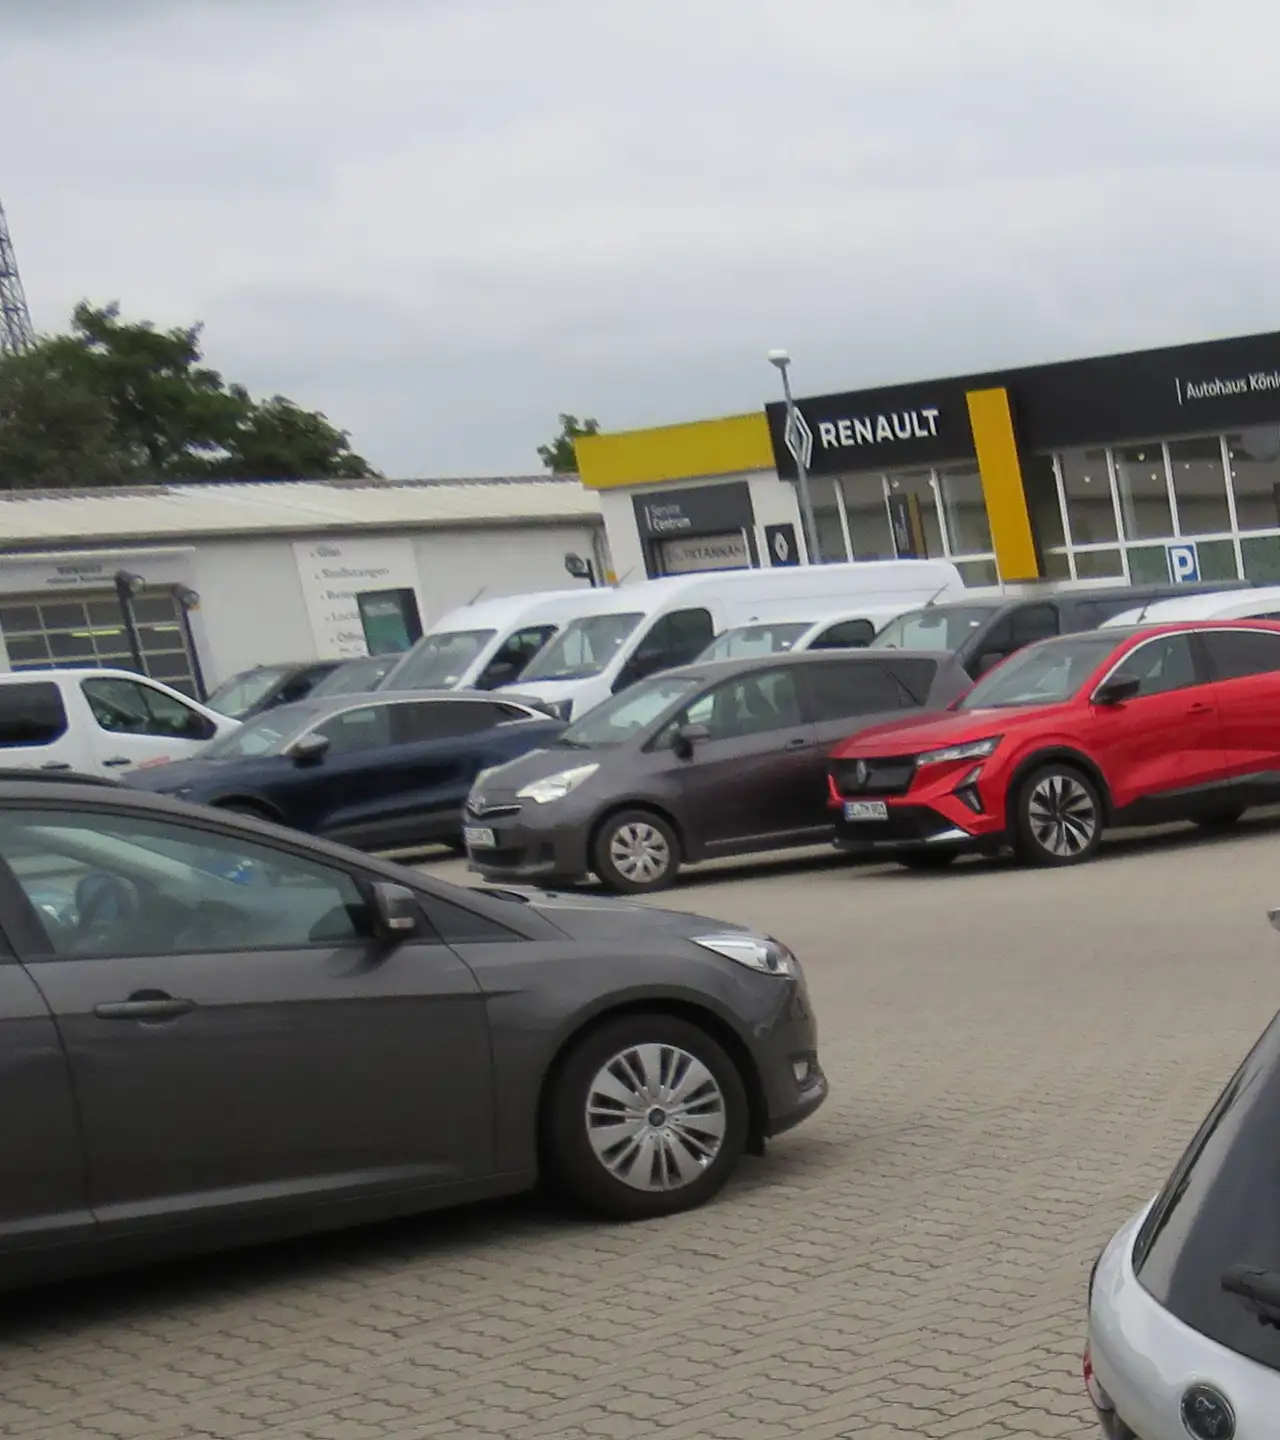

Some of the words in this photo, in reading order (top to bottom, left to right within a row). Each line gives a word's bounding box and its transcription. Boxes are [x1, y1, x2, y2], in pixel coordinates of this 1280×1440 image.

[1186, 376, 1247, 400] Autohaus
[818, 408, 940, 449] RENAULT
[1171, 548, 1194, 583] P
